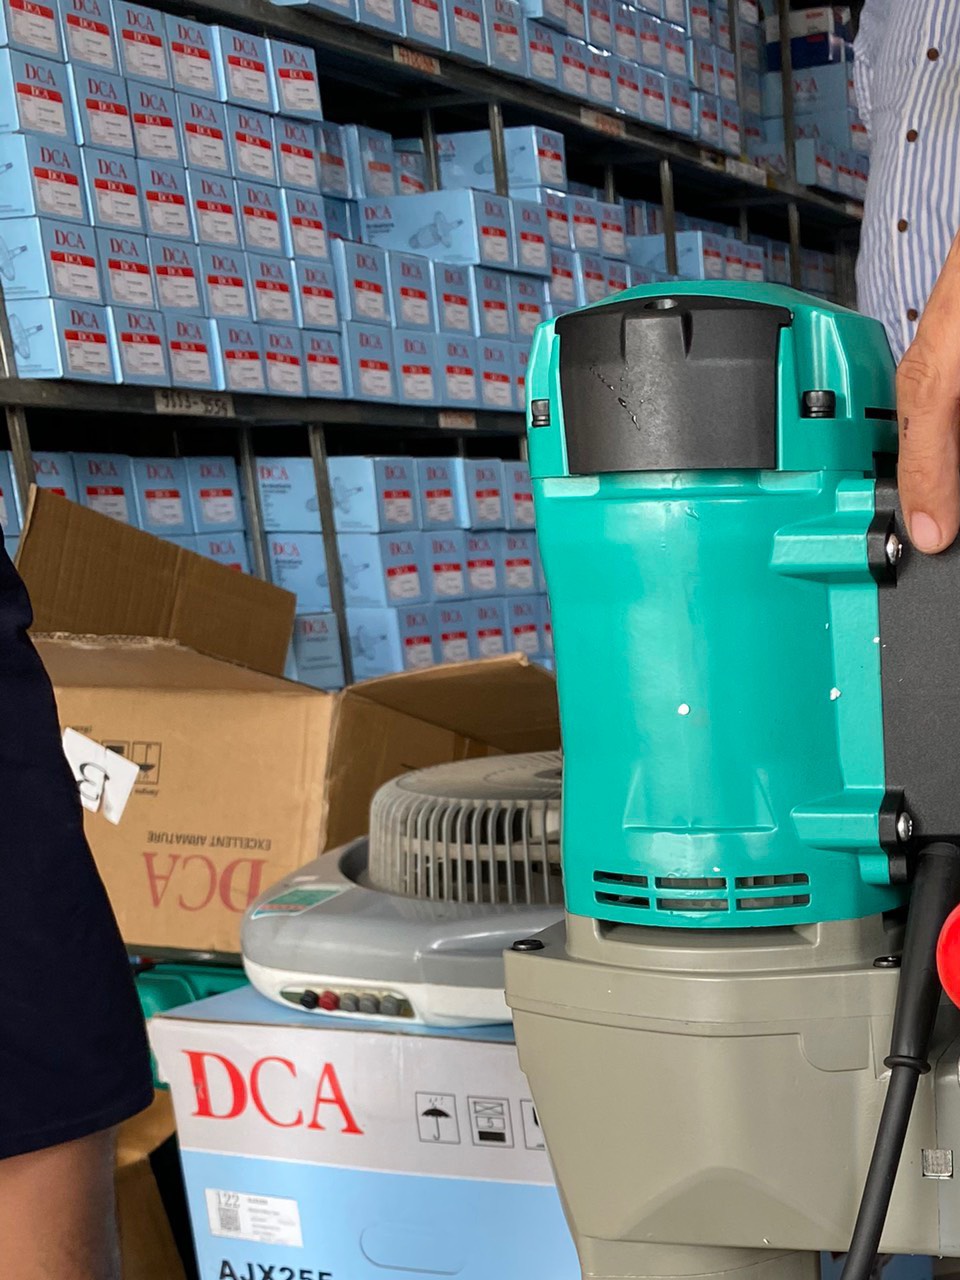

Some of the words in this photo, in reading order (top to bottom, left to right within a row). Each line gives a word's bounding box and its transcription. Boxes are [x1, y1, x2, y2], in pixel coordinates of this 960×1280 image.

[127, 9, 155, 31] DCA
[177, 24, 205, 45] DCA
[232, 36, 258, 57] DCA
[283, 49, 309, 68] DCA
[25, 63, 56, 86] DCA
[31, 86, 50, 98] DCA
[88, 78, 117, 99] DCA
[98, 101, 116, 113] DCA
[139, 91, 168, 113] DCA
[190, 102, 217, 123] DCA
[238, 114, 264, 134] DCA
[284, 124, 307, 143] DCA
[40, 146, 71, 169] DCA
[47, 170, 66, 183] DCA
[97, 158, 127, 179] DCA
[107, 182, 125, 193] DCA
[151, 170, 178, 190] DCA
[201, 179, 227, 199] DCA
[247, 187, 272, 207] DCA
[295, 198, 318, 217] DCA
[365, 205, 392, 221] DCA
[54, 229, 86, 250] DCA
[110, 238, 139, 257] DCA
[64, 252, 83, 265] DCA
[162, 246, 191, 265] DCA
[212, 255, 238, 273] DCA
[260, 262, 284, 279] DCA
[304, 268, 328, 285] DCA
[70, 309, 100, 329] DCA
[128, 313, 156, 331] DCA
[176, 321, 202, 340] DCA
[228, 328, 254, 345] DCA
[268, 333, 293, 349] DCA
[310, 337, 333, 352] DCA
[88, 460, 118, 477] DCA
[146, 464, 174, 480] DCA
[259, 466, 288, 480] DCA
[208, 540, 236, 556] DCA
[272, 541, 300, 556] DCA
[147, 830, 207, 847] ARMATURE
[209, 837, 272, 851] EXCELLENT
[142, 852, 269, 913] DCA
[181, 1049, 364, 1135] DCA
[217, 1190, 240, 1208] 122
